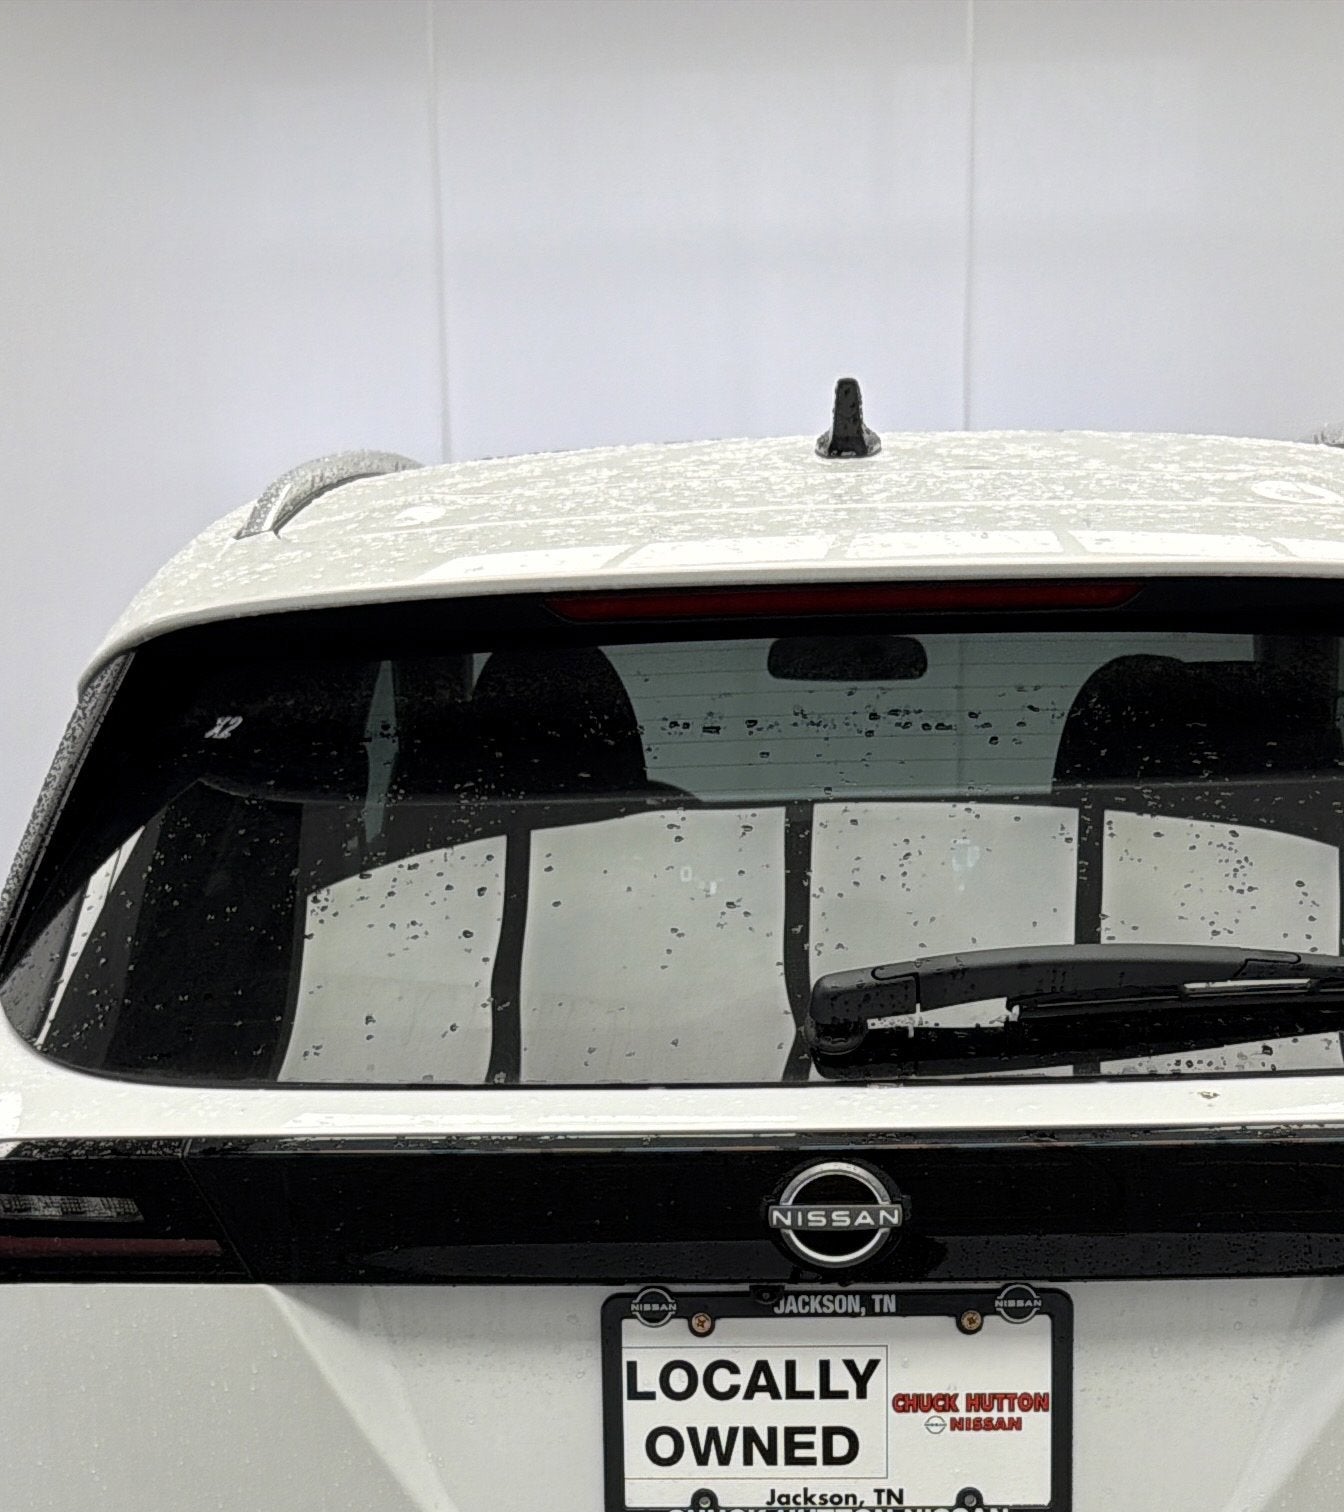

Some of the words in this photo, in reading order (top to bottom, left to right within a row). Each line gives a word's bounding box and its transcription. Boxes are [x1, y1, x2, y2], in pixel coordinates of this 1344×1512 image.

[772, 1209, 899, 1227] NISSAN
[631, 1303, 677, 1311] NISSAN
[773, 1295, 866, 1316] JACKSON,
[872, 1294, 896, 1313] TN
[995, 1299, 1042, 1307] NISSAN
[626, 1359, 882, 1401] LOCALLY
[892, 1393, 960, 1413] CHUCK
[965, 1392, 1050, 1412] HUTTON
[950, 1417, 1023, 1431] NISSAN
[645, 1426, 860, 1467] OWNED
[765, 1488, 865, 1508] Jackson,
[873, 1488, 904, 1506] TN
